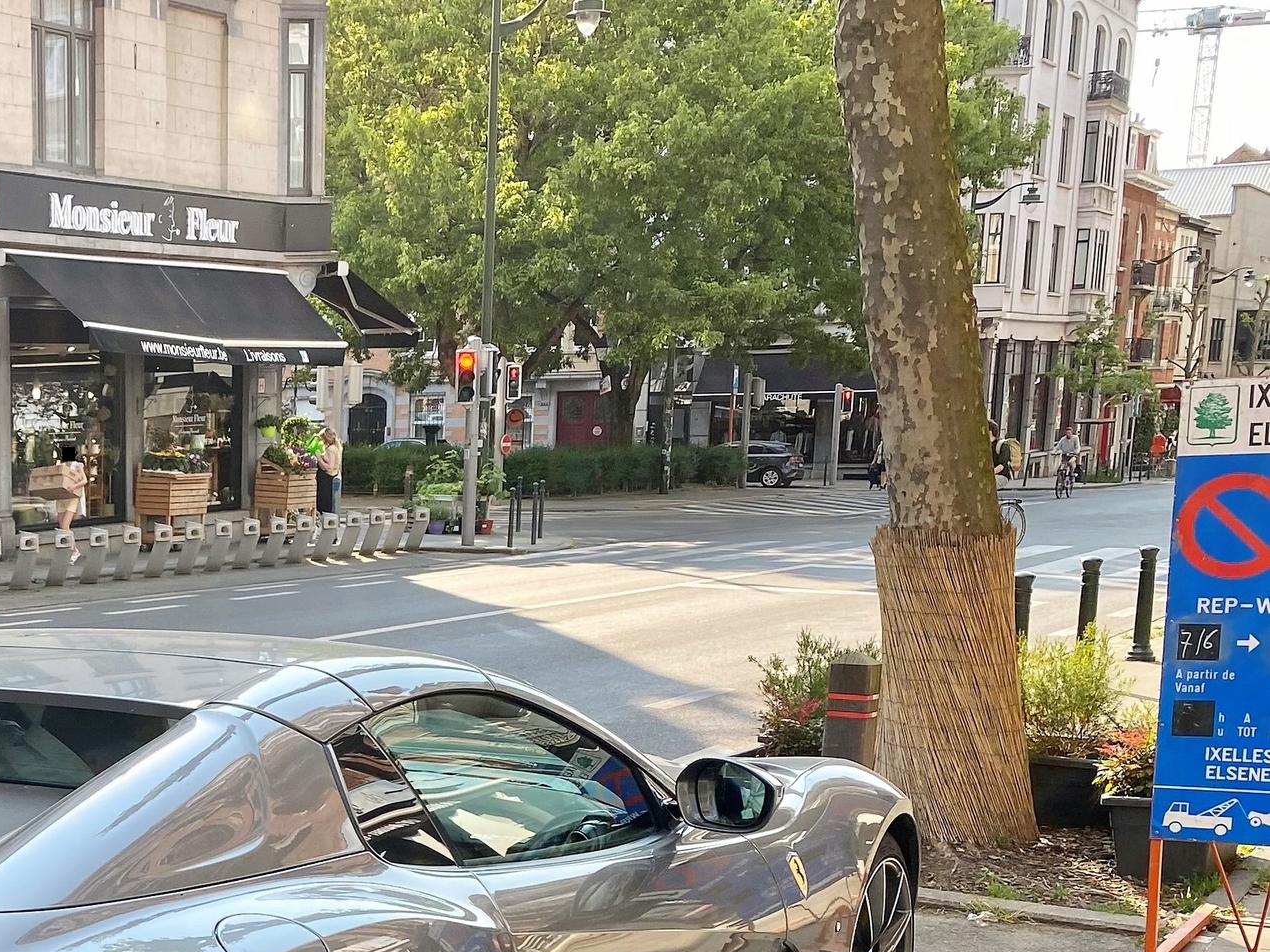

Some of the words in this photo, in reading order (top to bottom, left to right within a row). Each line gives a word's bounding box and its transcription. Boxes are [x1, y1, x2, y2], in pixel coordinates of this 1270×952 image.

[48, 193, 156, 237] Monsieur
[186, 206, 240, 244] Fleur
[140, 340, 229, 362] www.monsieurfleur.be
[243, 348, 287, 363] Livraisons
[1180, 628, 1219, 659] 7/6
[1175, 668, 1183, 679] A
[1186, 669, 1219, 682] partir
[1222, 669, 1236, 680] de
[1175, 682, 1206, 693] Vanaf
[1218, 712, 1225, 723] h
[1243, 712, 1251, 723] A
[1217, 728, 1224, 736] u
[1237, 726, 1258, 738] TOT
[1205, 765, 1270, 782] ELSENE
